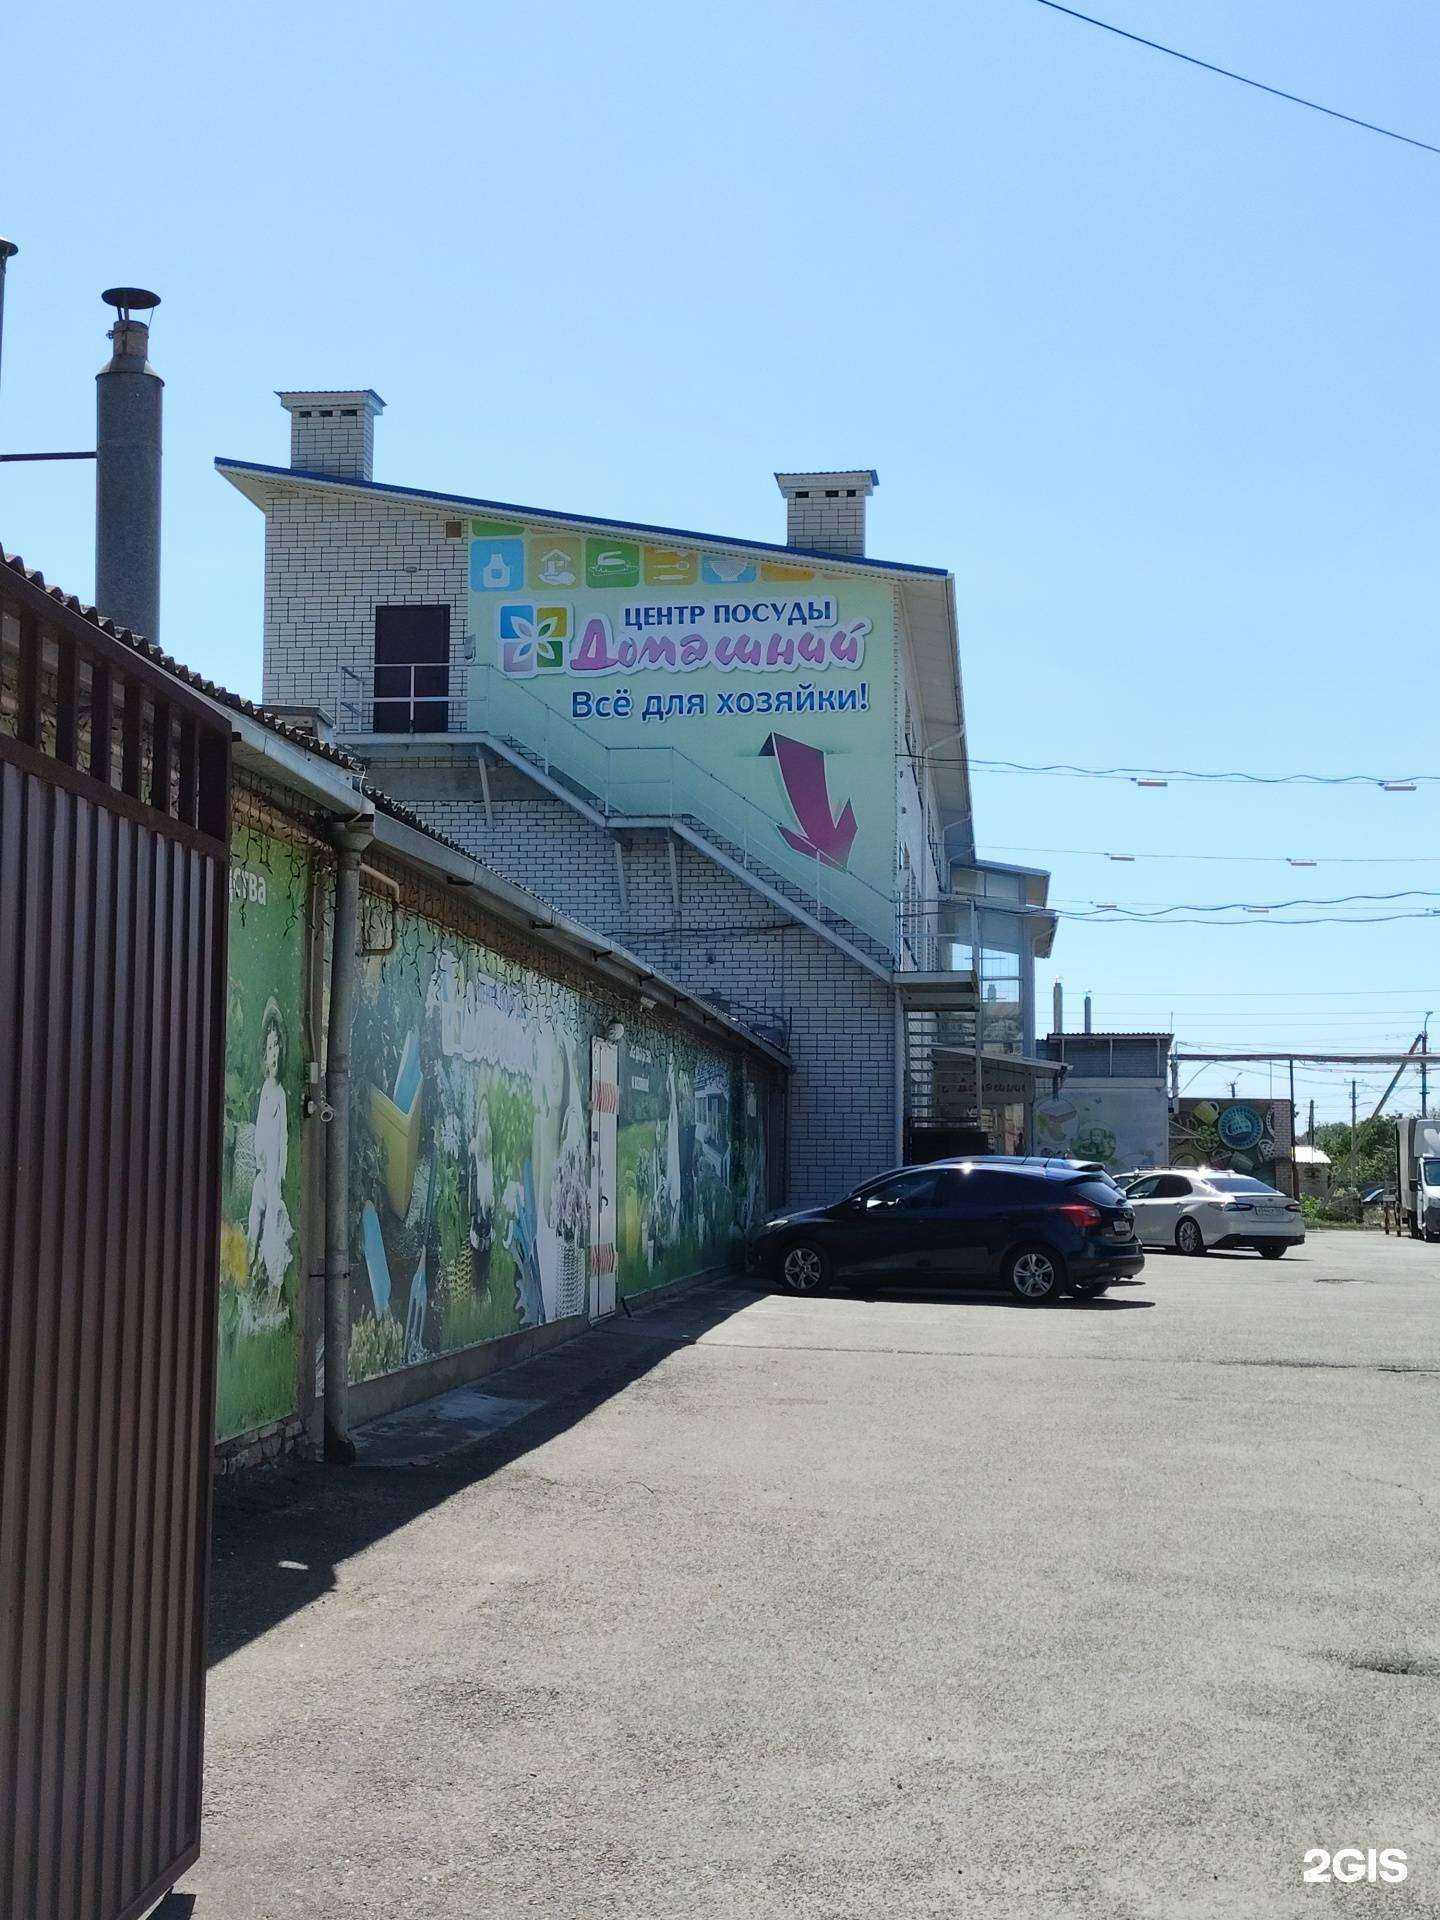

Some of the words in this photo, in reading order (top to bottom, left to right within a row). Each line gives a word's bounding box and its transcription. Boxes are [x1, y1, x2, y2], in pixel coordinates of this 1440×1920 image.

[624, 605, 706, 631] ЦЕНТР
[714, 601, 831, 626] ПОСУДЫ
[570, 618, 866, 671] Домашний
[572, 688, 631, 718] Всё
[642, 694, 705, 722] для
[716, 682, 868, 714] хозяйки!
